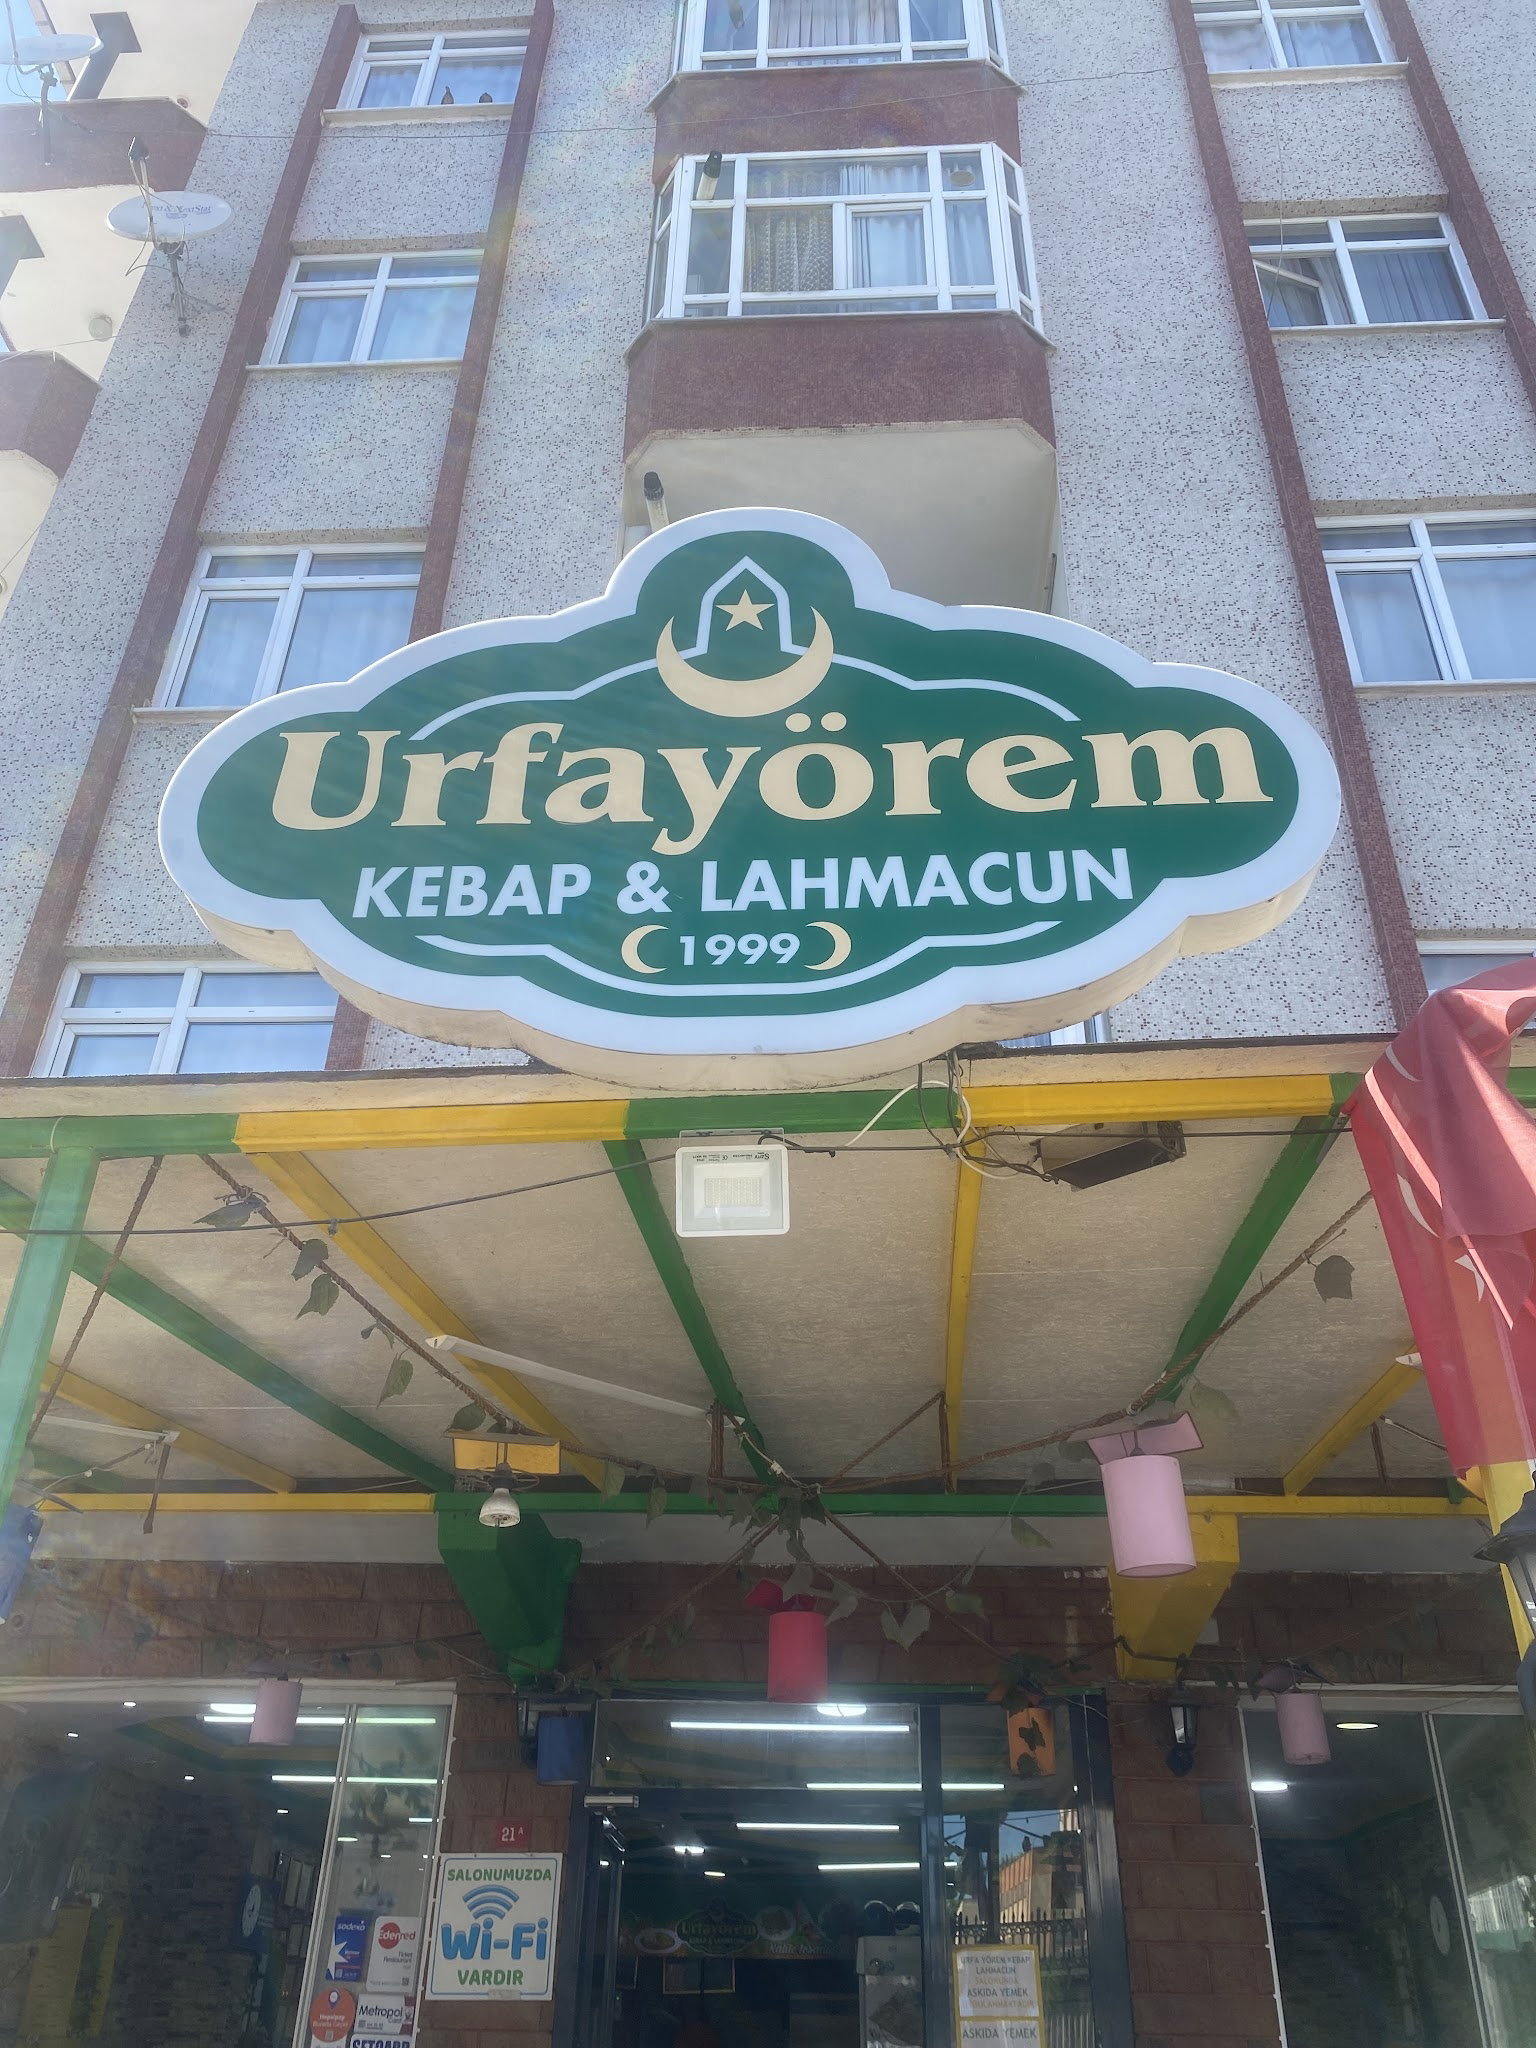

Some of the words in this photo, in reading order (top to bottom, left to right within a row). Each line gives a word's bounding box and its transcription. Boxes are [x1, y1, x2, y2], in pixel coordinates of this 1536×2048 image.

[271, 711, 1274, 856] Urfayörem
[352, 862, 592, 919] KEBAP
[616, 860, 673, 915] &
[700, 847, 1133, 912] LAHMACUN
[679, 932, 801, 966] 1999
[447, 1868, 552, 1882] SALONUMUZDA
[337, 1922, 365, 1932] sodexo
[379, 1929, 416, 1941] Edenred
[441, 1917, 549, 1961] Wi-Fi
[457, 1969, 524, 1986] VARDIR
[976, 1967, 1016, 1975] LAHMACUN
[967, 1988, 998, 1997] ASKIDA
[1000, 1988, 1028, 1997] YEMEK
[358, 2005, 403, 2019] Metropol
[963, 2027, 999, 2039] ASKIDA
[1004, 2027, 1037, 2039] YEMEK
